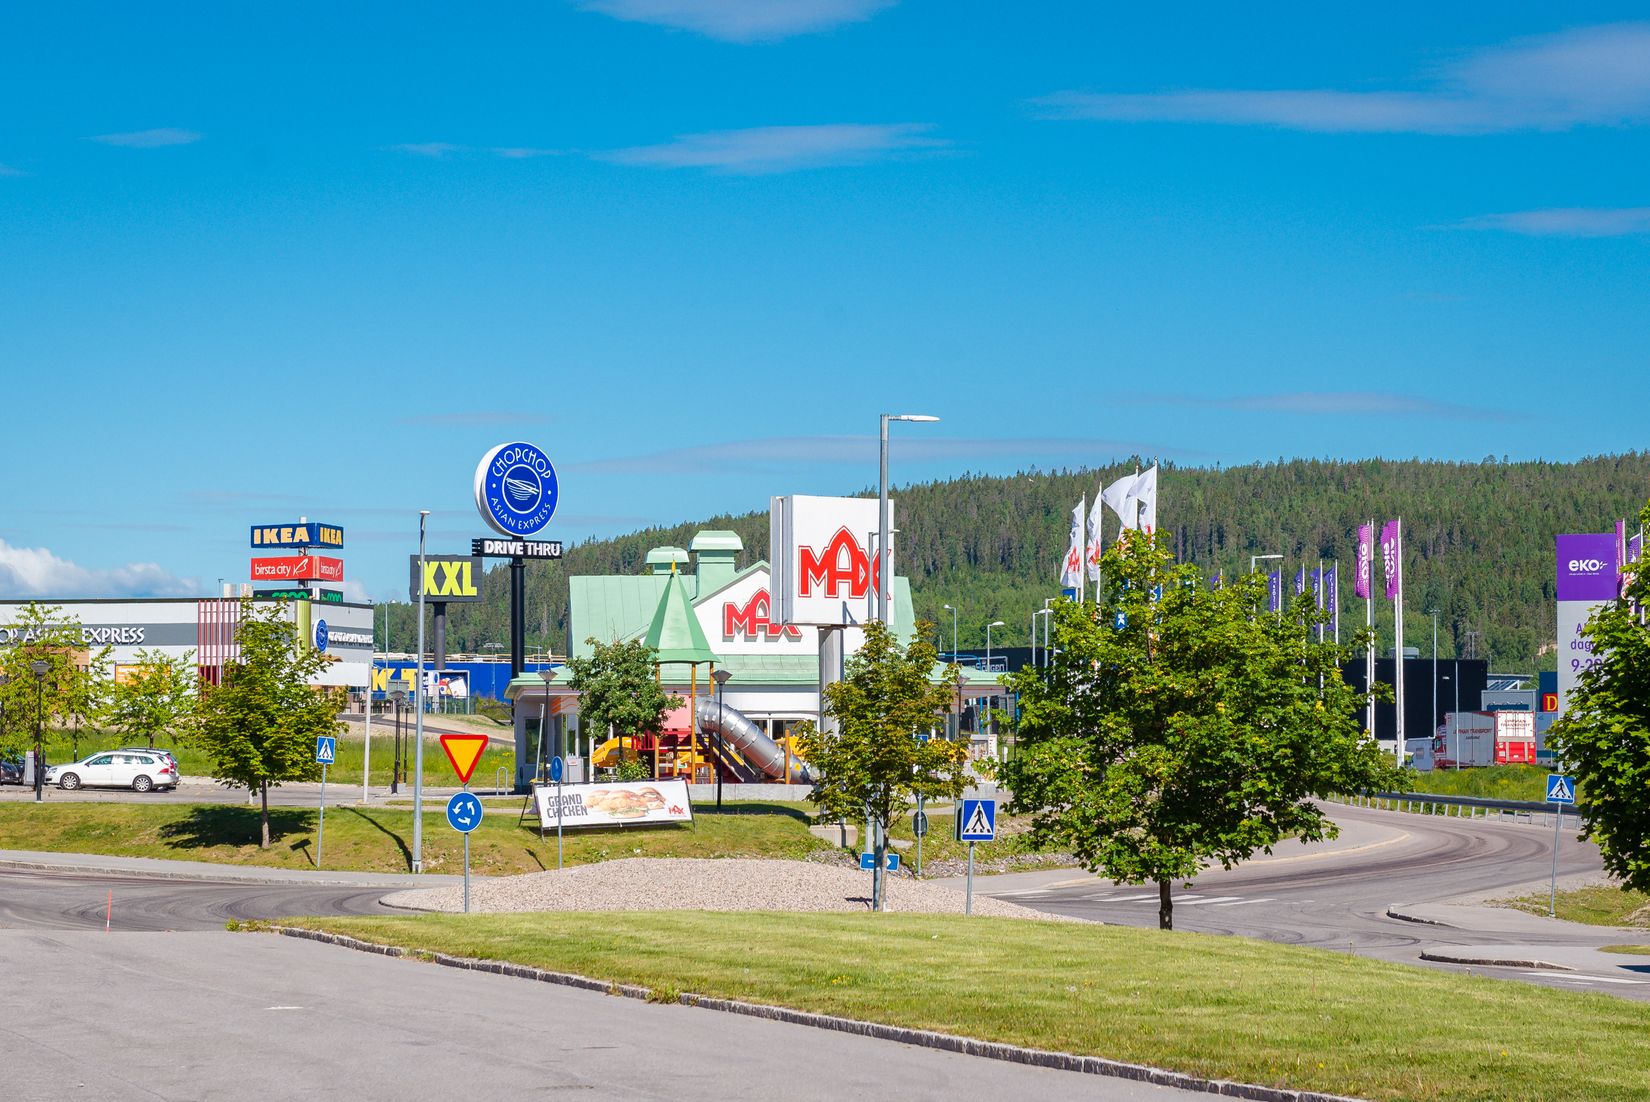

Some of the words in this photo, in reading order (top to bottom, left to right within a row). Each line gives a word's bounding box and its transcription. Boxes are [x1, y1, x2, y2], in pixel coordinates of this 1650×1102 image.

[492, 448, 551, 478] CHOPCHOP
[491, 497, 515, 527] ASIAN
[518, 503, 551, 530] EXPRESS
[253, 526, 310, 545] IKEA
[320, 527, 343, 546] IKEA
[483, 540, 524, 555] DRIVE
[525, 542, 561, 556] THRU
[255, 563, 276, 576] birsta
[277, 563, 292, 577] city
[798, 525, 892, 601] MAX
[417, 561, 478, 596] XXL
[724, 587, 803, 638] MA
[81, 627, 145, 643] EXPRESS
[548, 793, 583, 807] GRAND
[547, 805, 588, 818] CHICKEN
